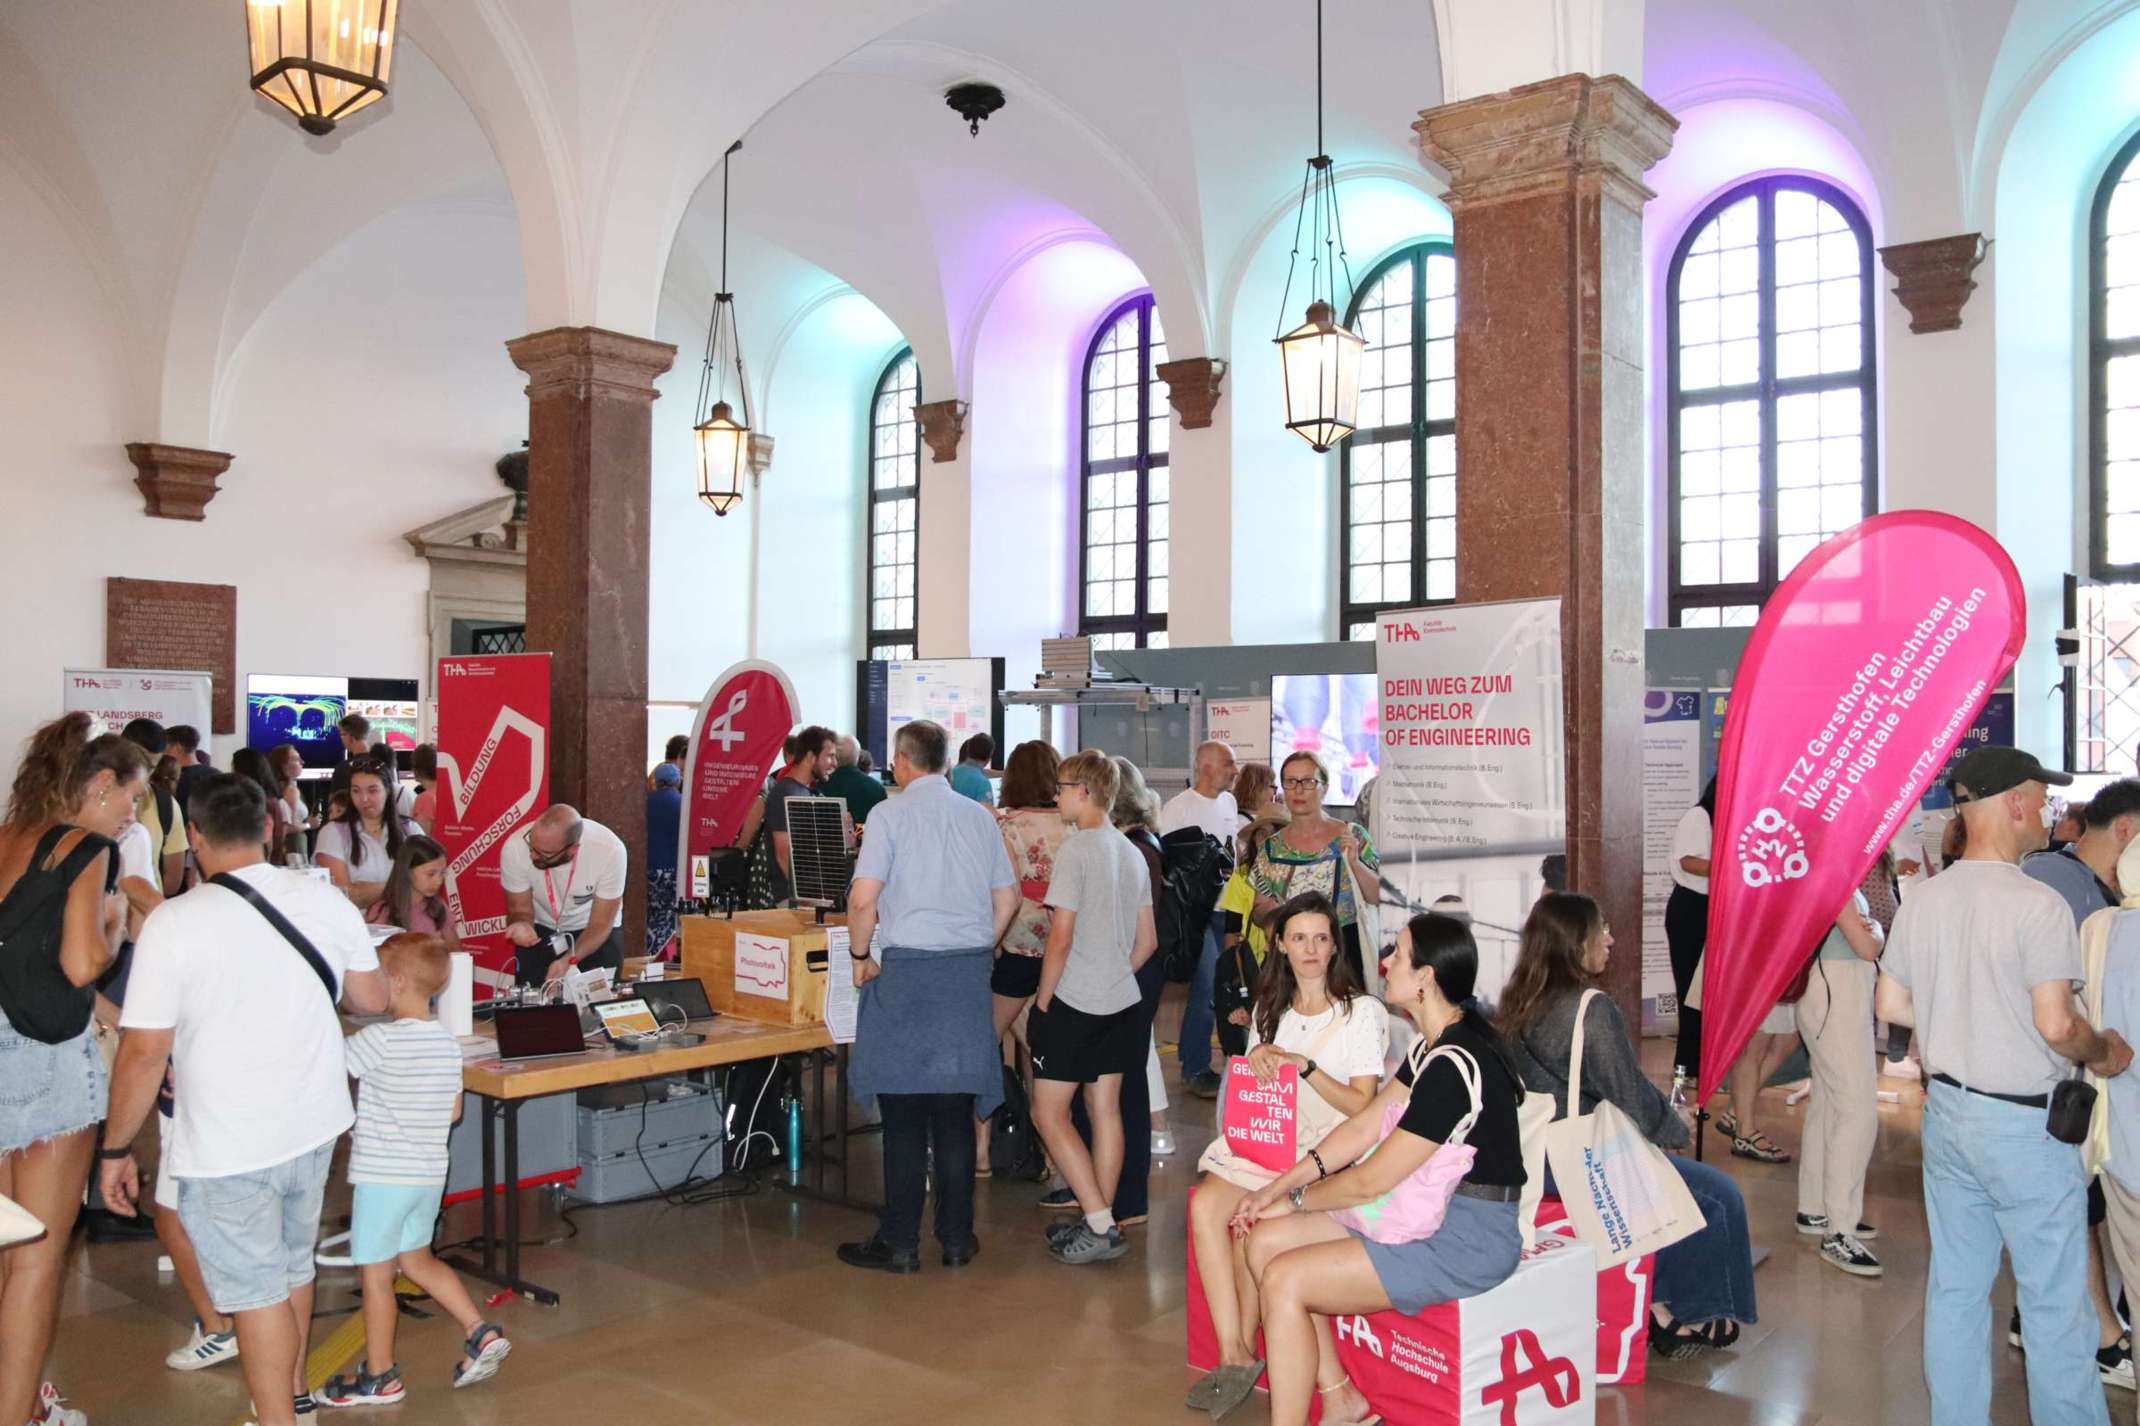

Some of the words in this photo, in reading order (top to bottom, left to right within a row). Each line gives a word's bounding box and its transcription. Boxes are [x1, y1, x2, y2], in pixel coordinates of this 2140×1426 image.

[1384, 623, 1420, 642] THA
[443, 663, 467, 676] THA
[1385, 679, 1422, 697] DEIN
[1426, 677, 1467, 695] WEG
[1471, 675, 1512, 694] ZUM
[97, 711, 163, 720] LANDSBERG
[1385, 702, 1473, 721] BACHELOR
[1798, 691, 1890, 810] Wasserstoff,
[1878, 595, 1952, 690] Leichtbau
[1821, 783, 1853, 823] und
[1847, 712, 1900, 784] digitale
[1890, 587, 1987, 709] Technologien
[1385, 729, 1405, 746] OF
[1408, 727, 1531, 746] ENGINEERING
[1778, 756, 1816, 797] TTZ
[1808, 651, 1887, 758] Gersthofen
[460, 738, 497, 805] BILDUNG
[1863, 679, 1987, 855] www.tha.de/TTZ-Gersthofen
[452, 805, 522, 874] FORSCHUNG
[449, 893, 464, 924] ENT
[464, 918, 508, 935] WICKL
[1238, 1089, 1286, 1106] GESTAL
[1250, 1117, 1281, 1131] WIR
[1266, 1106, 1293, 1120] TEN
[1227, 1126, 1248, 1140] DIE
[1249, 1129, 1285, 1144] WELT
[1602, 1212, 1622, 1254] Lange
[1336, 1314, 1384, 1359] HA
[1391, 1329, 1446, 1360] Technische
[1391, 1341, 1449, 1374] Hochschule
[1391, 1354, 1438, 1384] Augsburg
